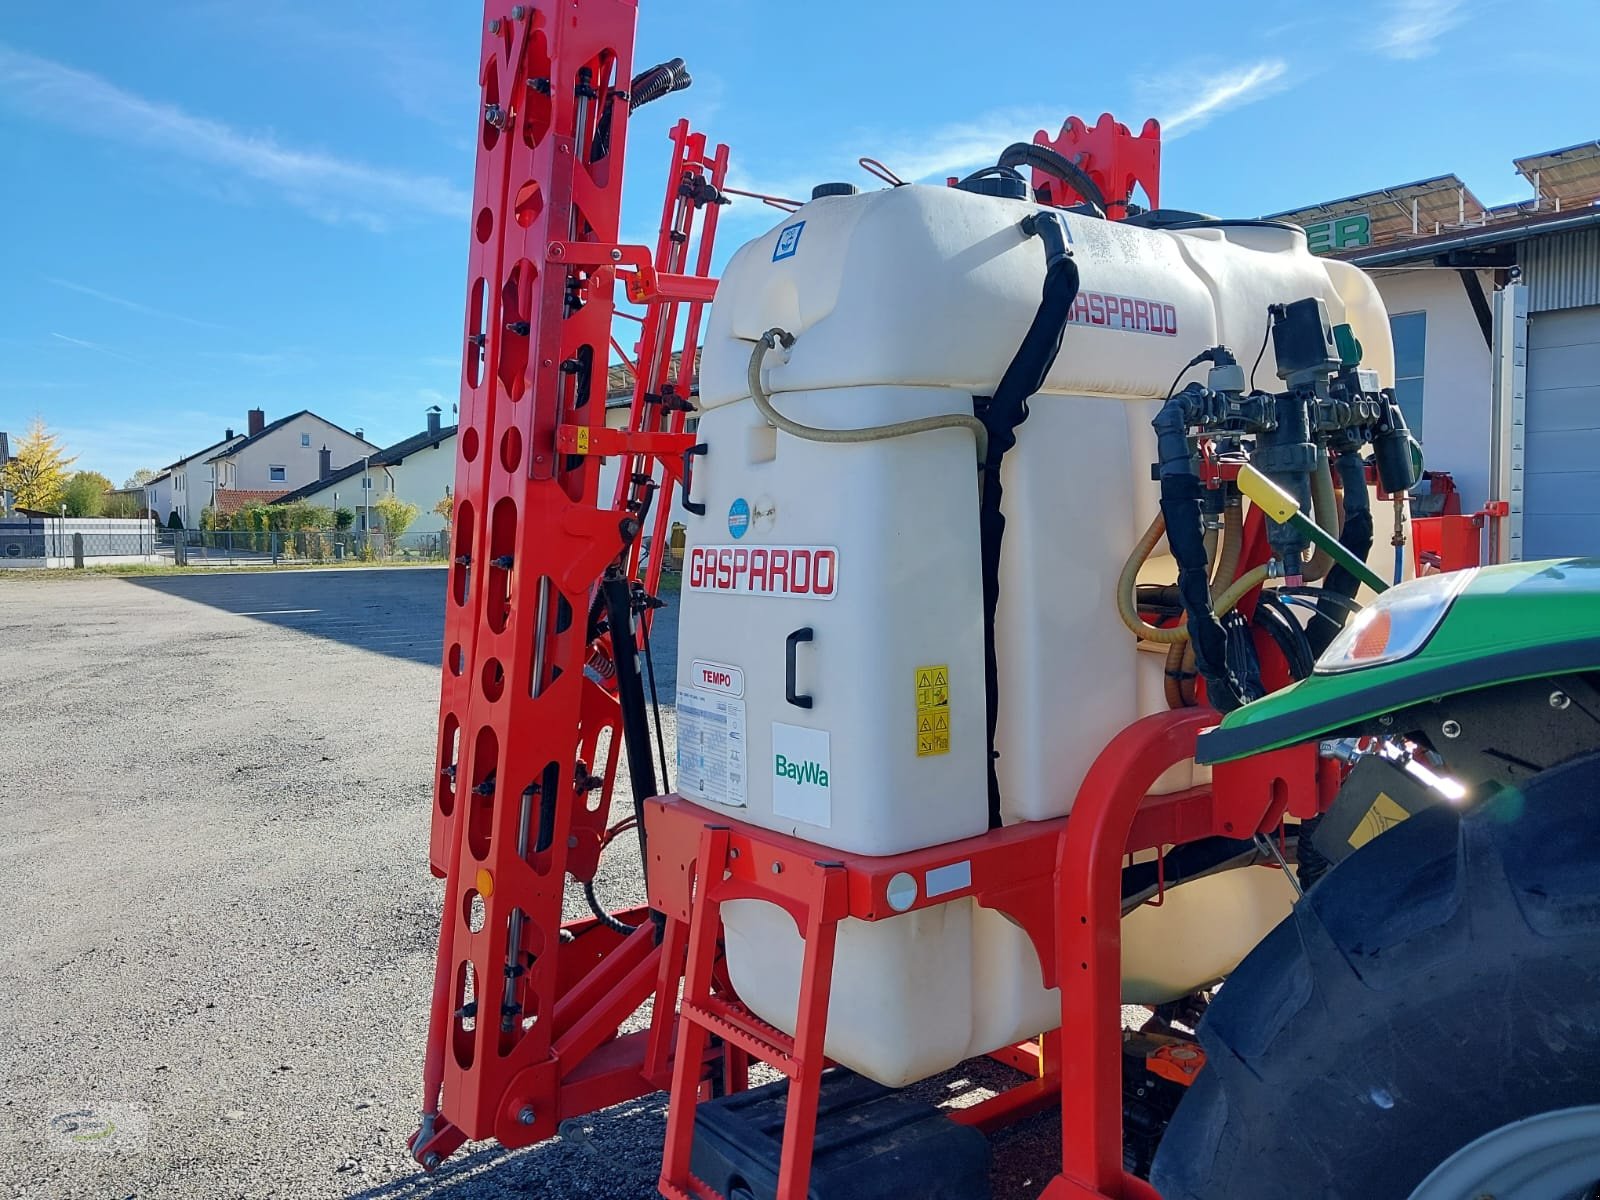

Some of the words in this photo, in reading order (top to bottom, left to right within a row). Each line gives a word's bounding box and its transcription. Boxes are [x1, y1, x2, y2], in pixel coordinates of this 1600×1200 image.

[690, 548, 836, 595] GASPARDO
[702, 669, 731, 687] TEMPO
[775, 754, 829, 787] BayWa
